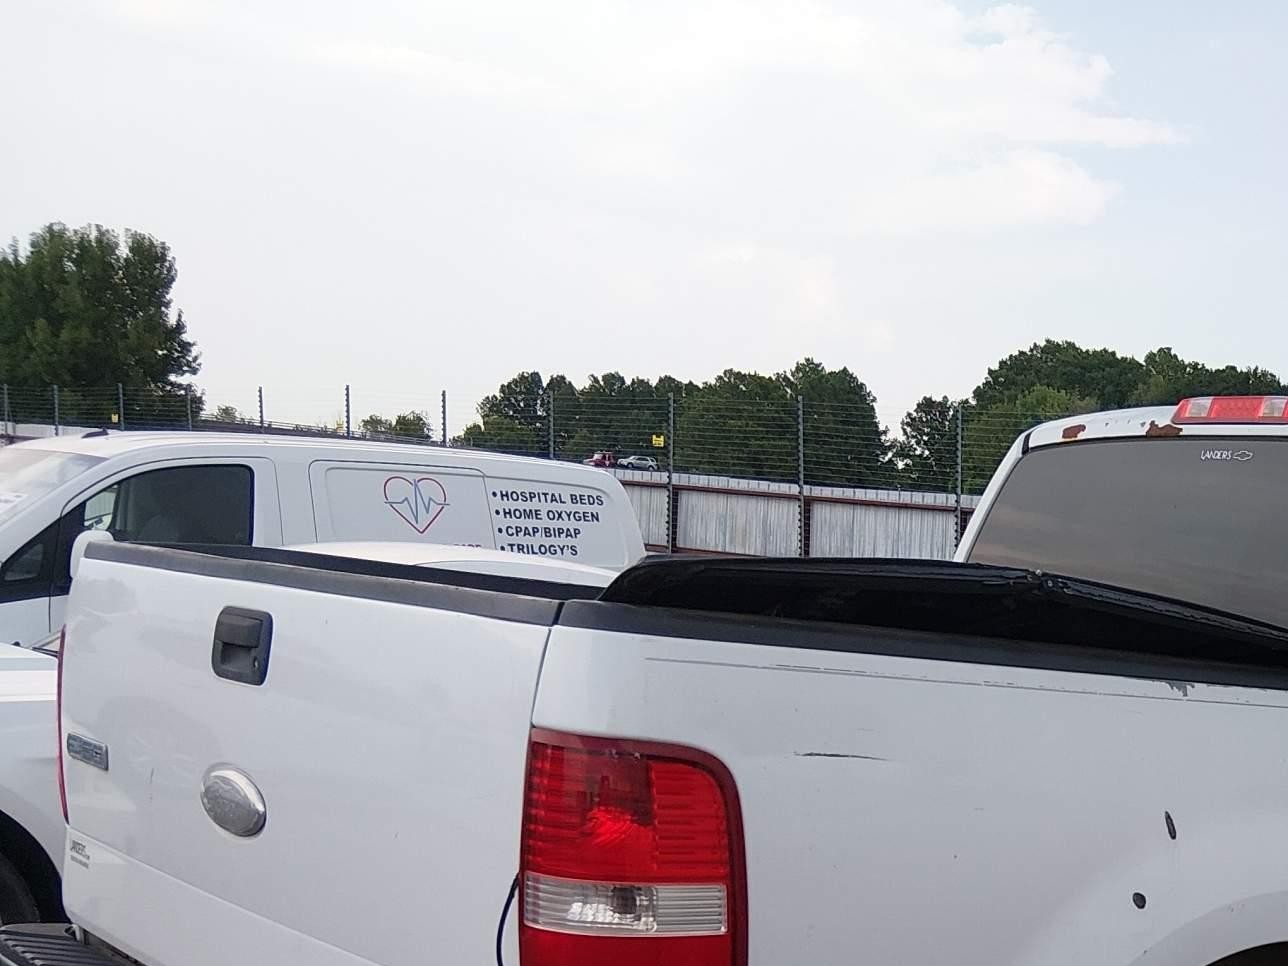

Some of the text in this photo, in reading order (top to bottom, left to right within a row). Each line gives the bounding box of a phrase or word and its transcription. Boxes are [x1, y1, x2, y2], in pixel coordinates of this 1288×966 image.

[500, 490, 604, 506] HOSPITAL BEDS
[503, 508, 600, 522] HOME OXYGEN
[505, 525, 581, 539] CPAP/BIPAP
